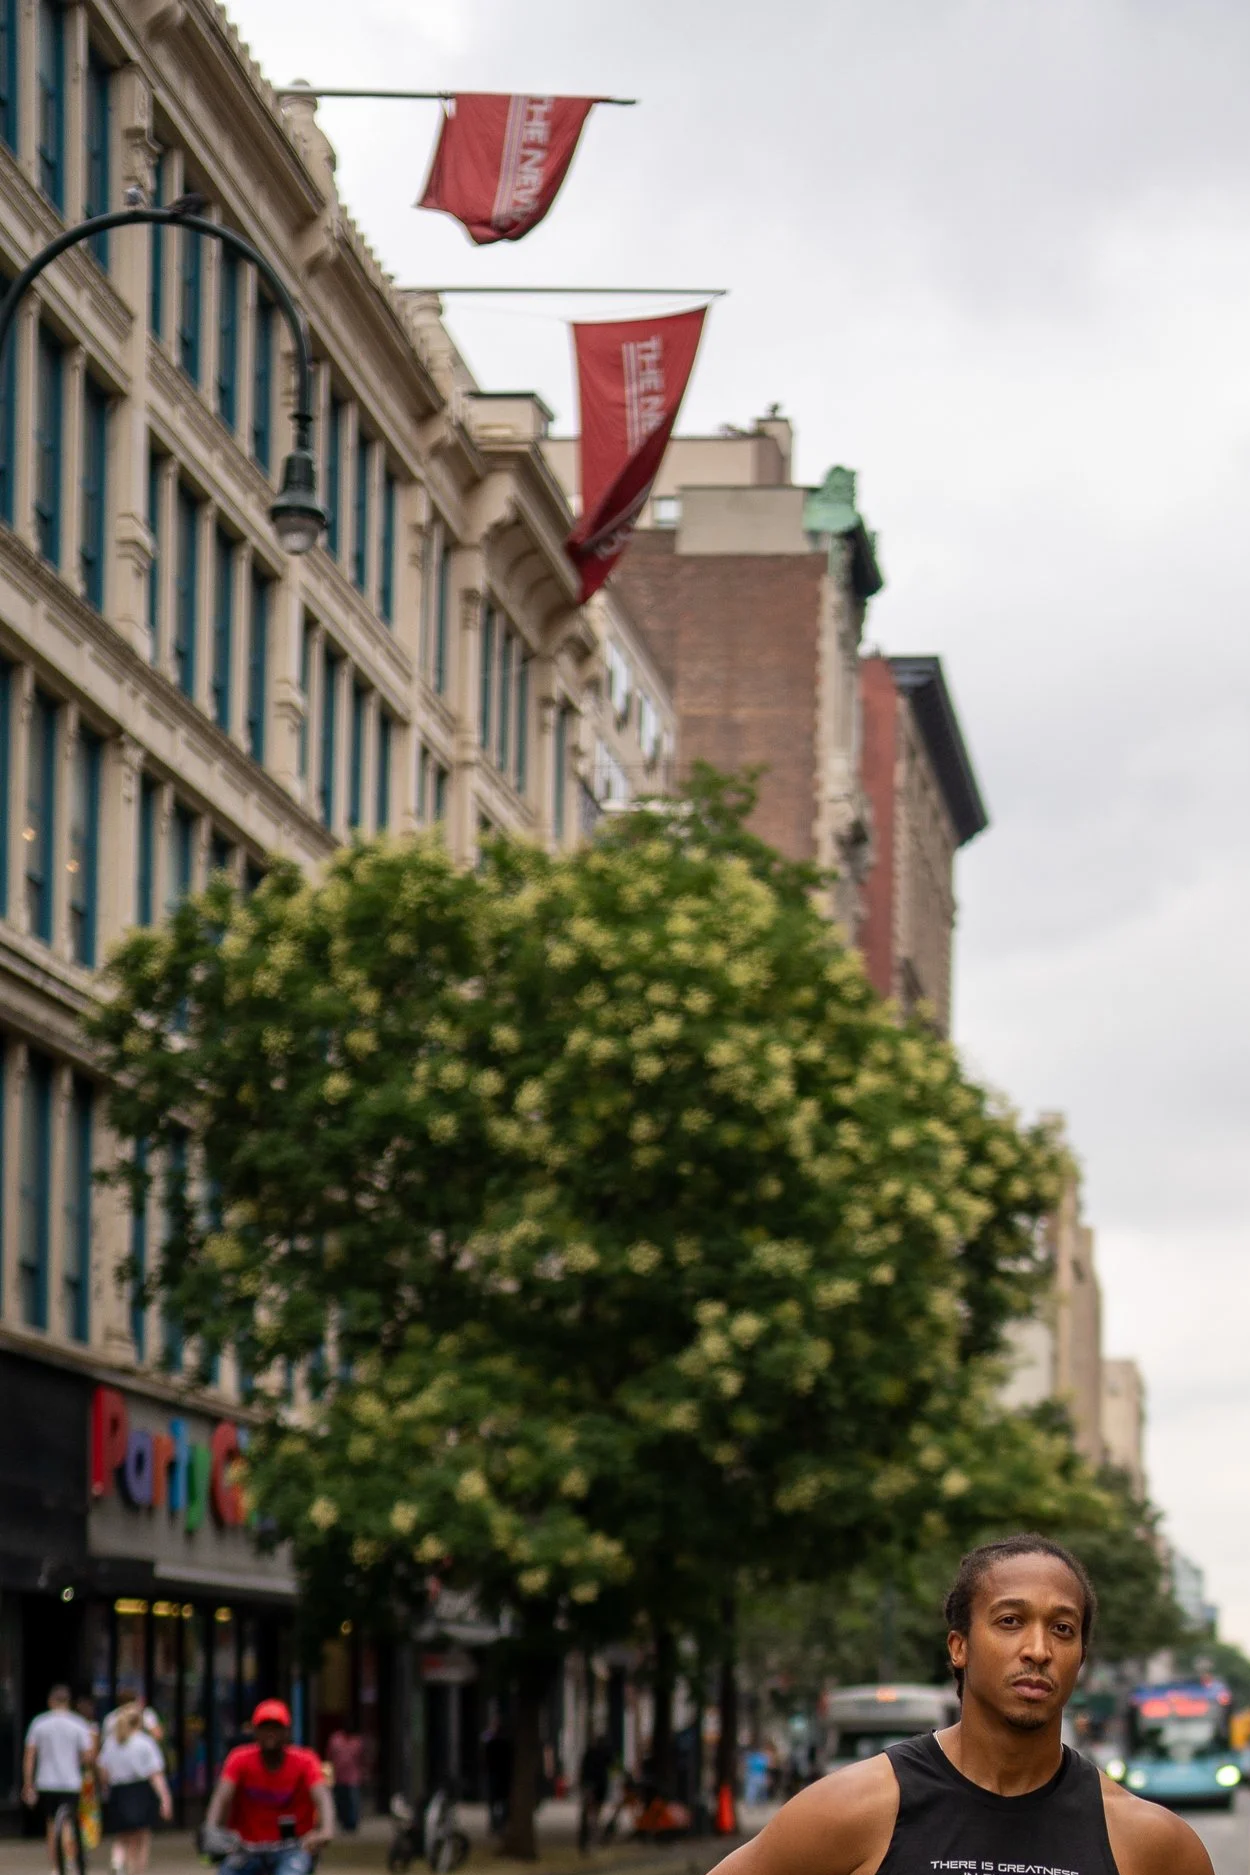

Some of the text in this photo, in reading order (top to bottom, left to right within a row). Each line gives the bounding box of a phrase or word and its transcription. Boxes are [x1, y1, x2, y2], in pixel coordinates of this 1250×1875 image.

[637, 335, 666, 393] THE
[90, 1384, 212, 1530] Party
[930, 1860, 977, 1870] THERE
[981, 1861, 994, 1871] IS
